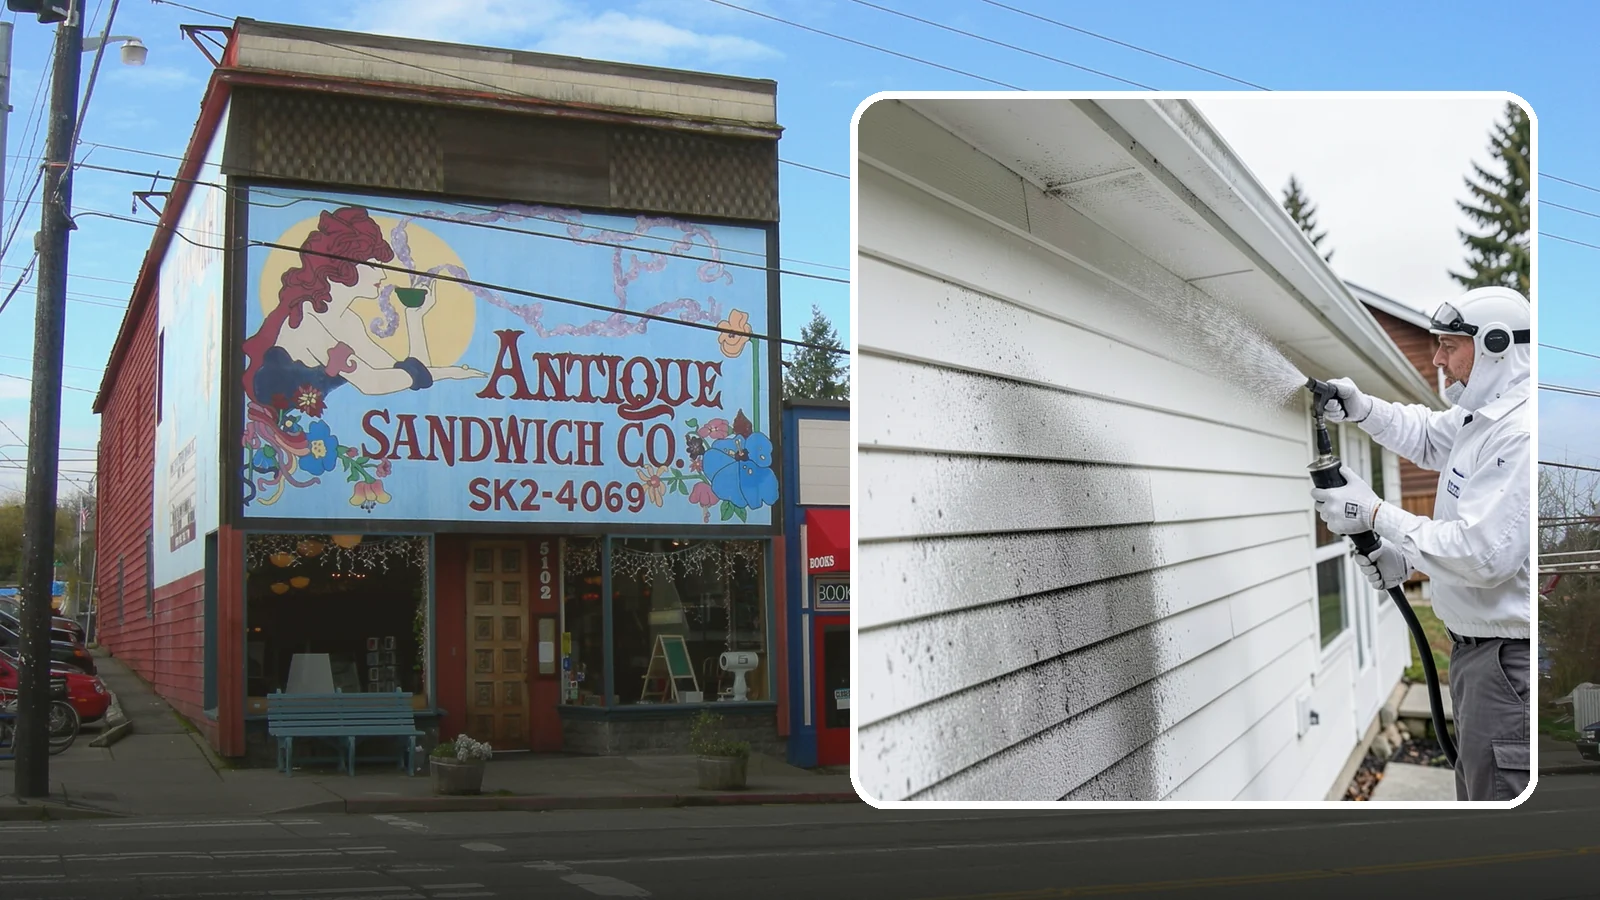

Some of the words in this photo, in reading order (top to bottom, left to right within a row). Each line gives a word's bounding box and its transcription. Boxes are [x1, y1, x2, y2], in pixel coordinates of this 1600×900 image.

[476, 329, 724, 421] ANTIQUE
[361, 409, 604, 468] SANDWICH
[616, 422, 685, 469] CO.
[468, 477, 646, 513] SK2-4069
[539, 541, 552, 600] 5102
[809, 555, 835, 569] BOOKS
